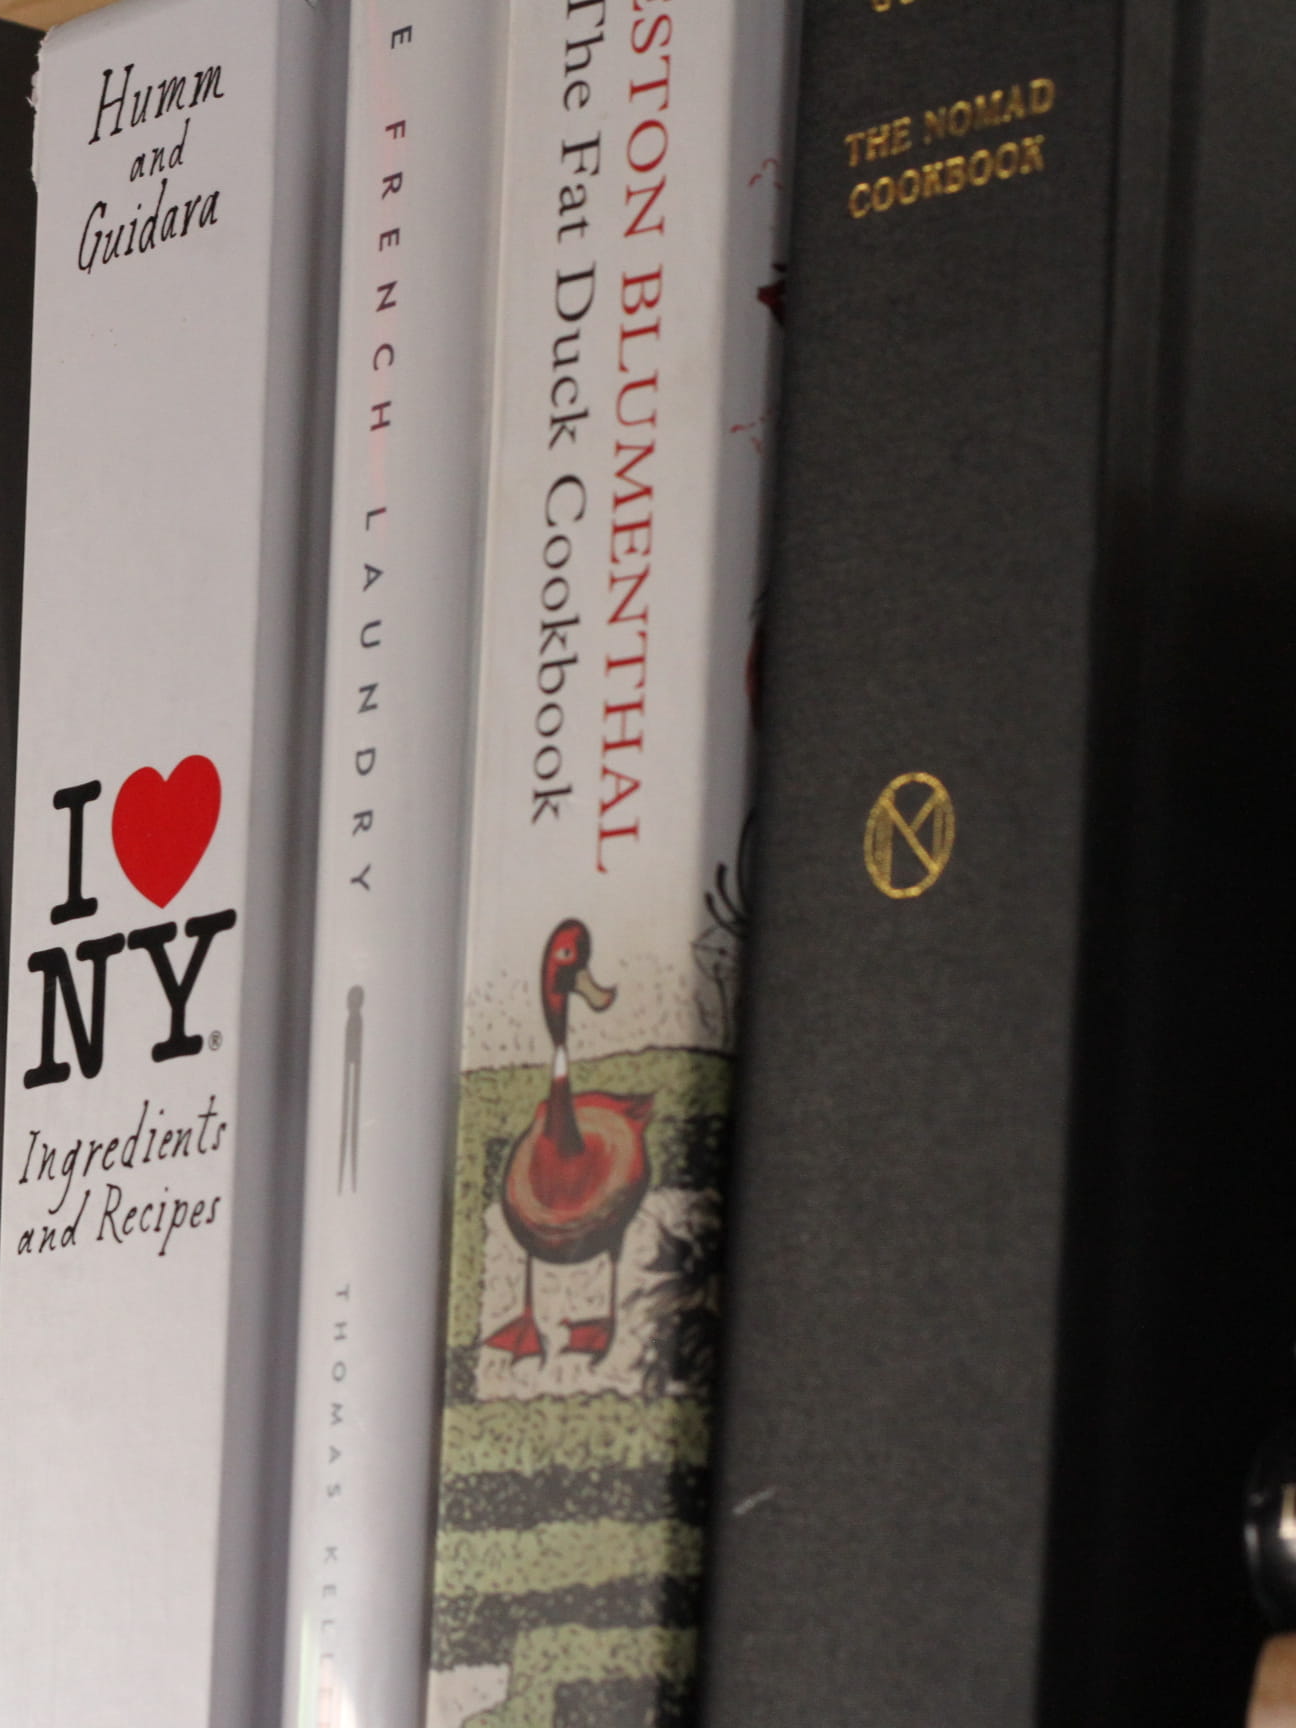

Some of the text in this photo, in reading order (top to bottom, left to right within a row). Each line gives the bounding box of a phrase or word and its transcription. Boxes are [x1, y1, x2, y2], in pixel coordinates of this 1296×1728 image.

[88, 63, 225, 146] Humm
[129, 117, 191, 182] and
[844, 77, 1056, 167] THE NOMAD
[77, 177, 221, 275] Guidara
[557, 131, 602, 244] Fat
[848, 134, 1046, 220] COOKBOOK
[369, 120, 407, 432] FRENCH
[547, 261, 597, 450] Duck
[595, 263, 663, 874] BLUMENTHAL
[350, 506, 388, 892] LAUNDRY
[531, 473, 588, 825] Cookbook
[52, 779, 102, 926] I
[18, 1094, 228, 1215] Ingredients
[17, 1183, 222, 1257] and Recipes
[326, 1284, 351, 1499] THOMAS
